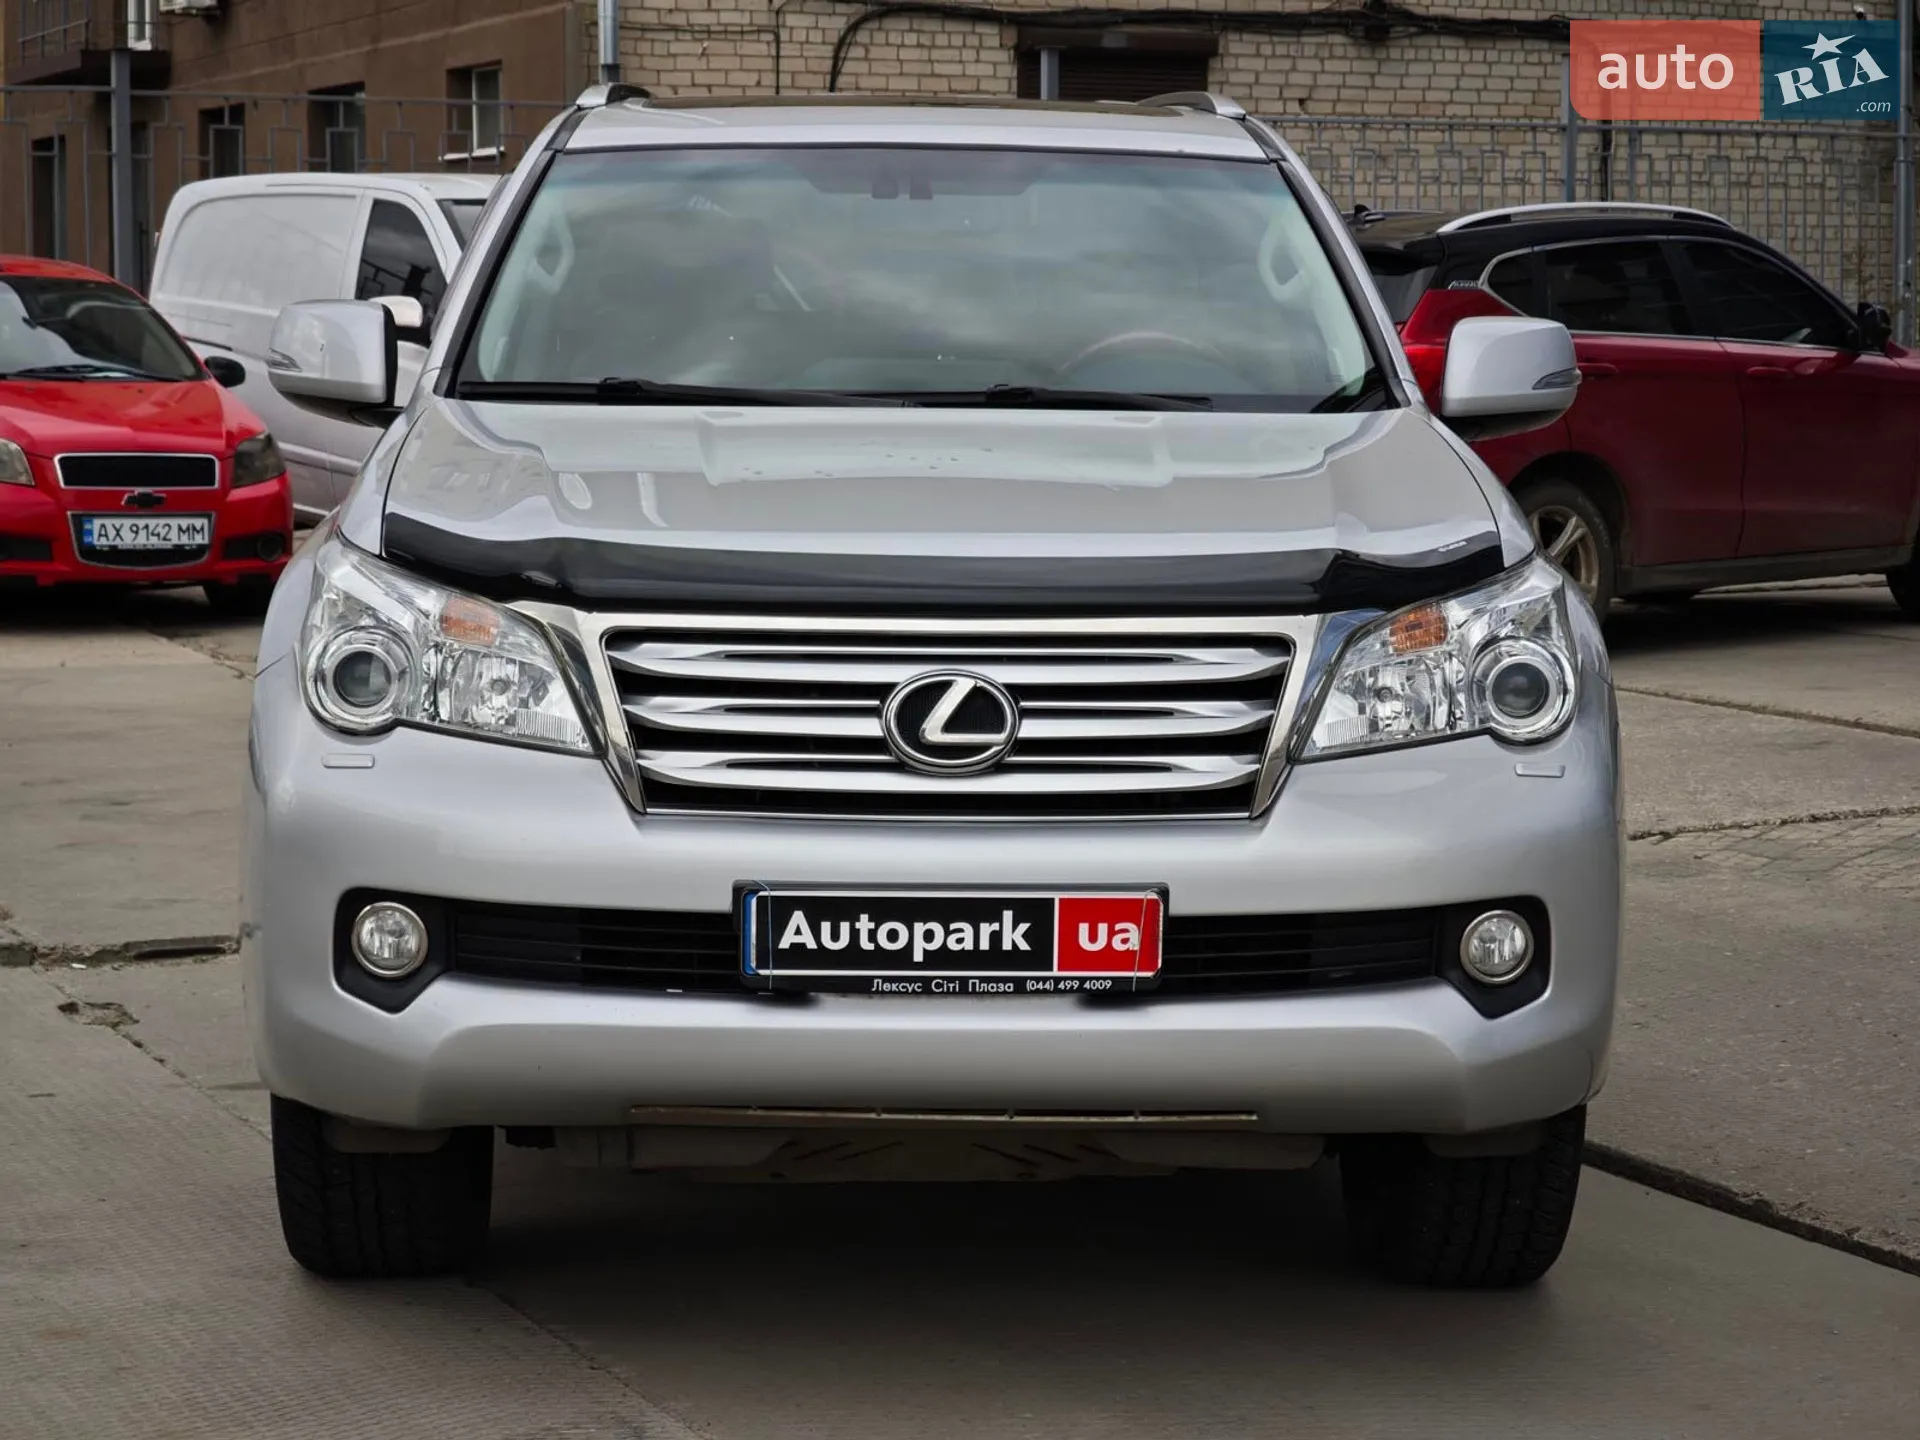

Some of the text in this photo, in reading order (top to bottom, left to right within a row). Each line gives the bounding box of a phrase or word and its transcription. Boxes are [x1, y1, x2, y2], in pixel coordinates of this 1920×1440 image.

[96, 522, 205, 543] AX 9142 MM
[777, 909, 1141, 963] Autopark ua
[871, 978, 1113, 993] Лексус Сіті Плаза (044) 499 4009
